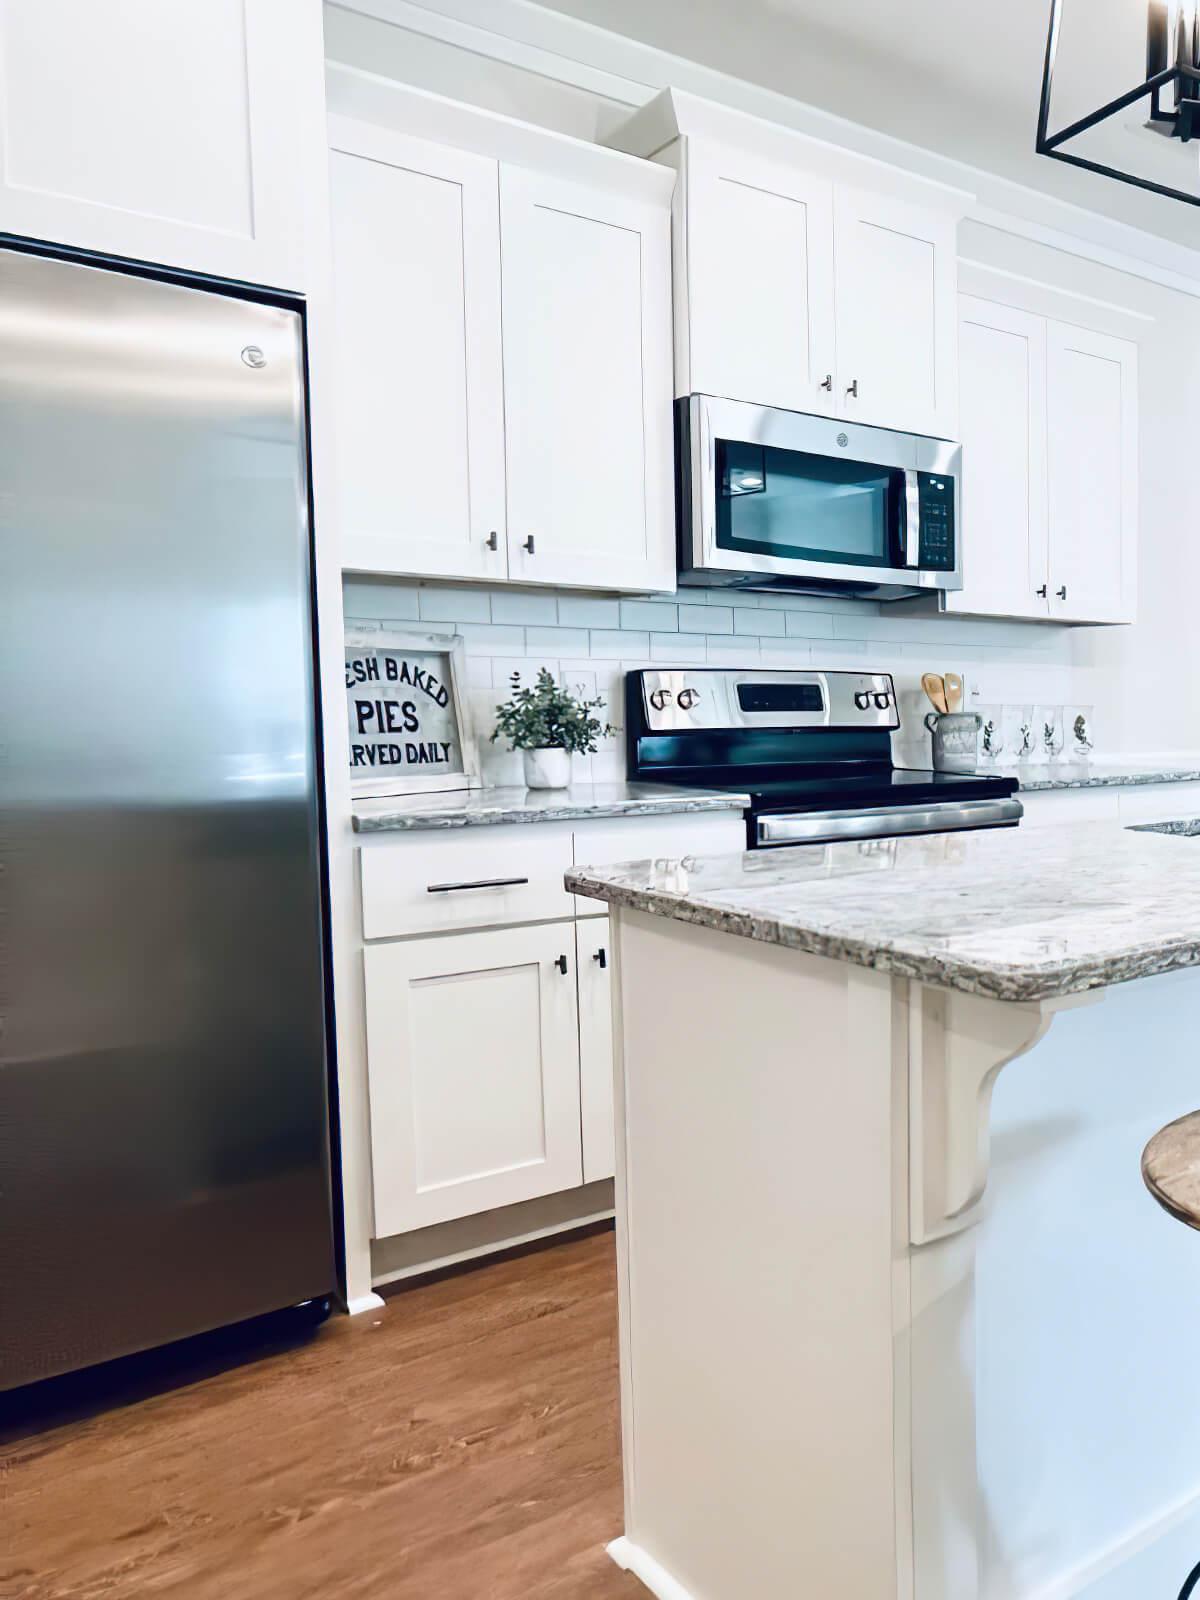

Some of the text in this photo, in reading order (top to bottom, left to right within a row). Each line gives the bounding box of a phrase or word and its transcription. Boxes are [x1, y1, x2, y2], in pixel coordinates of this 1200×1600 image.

[385, 657, 449, 708] BAKED
[355, 700, 419, 734] PIES
[349, 742, 451, 766] RVED DAILY
